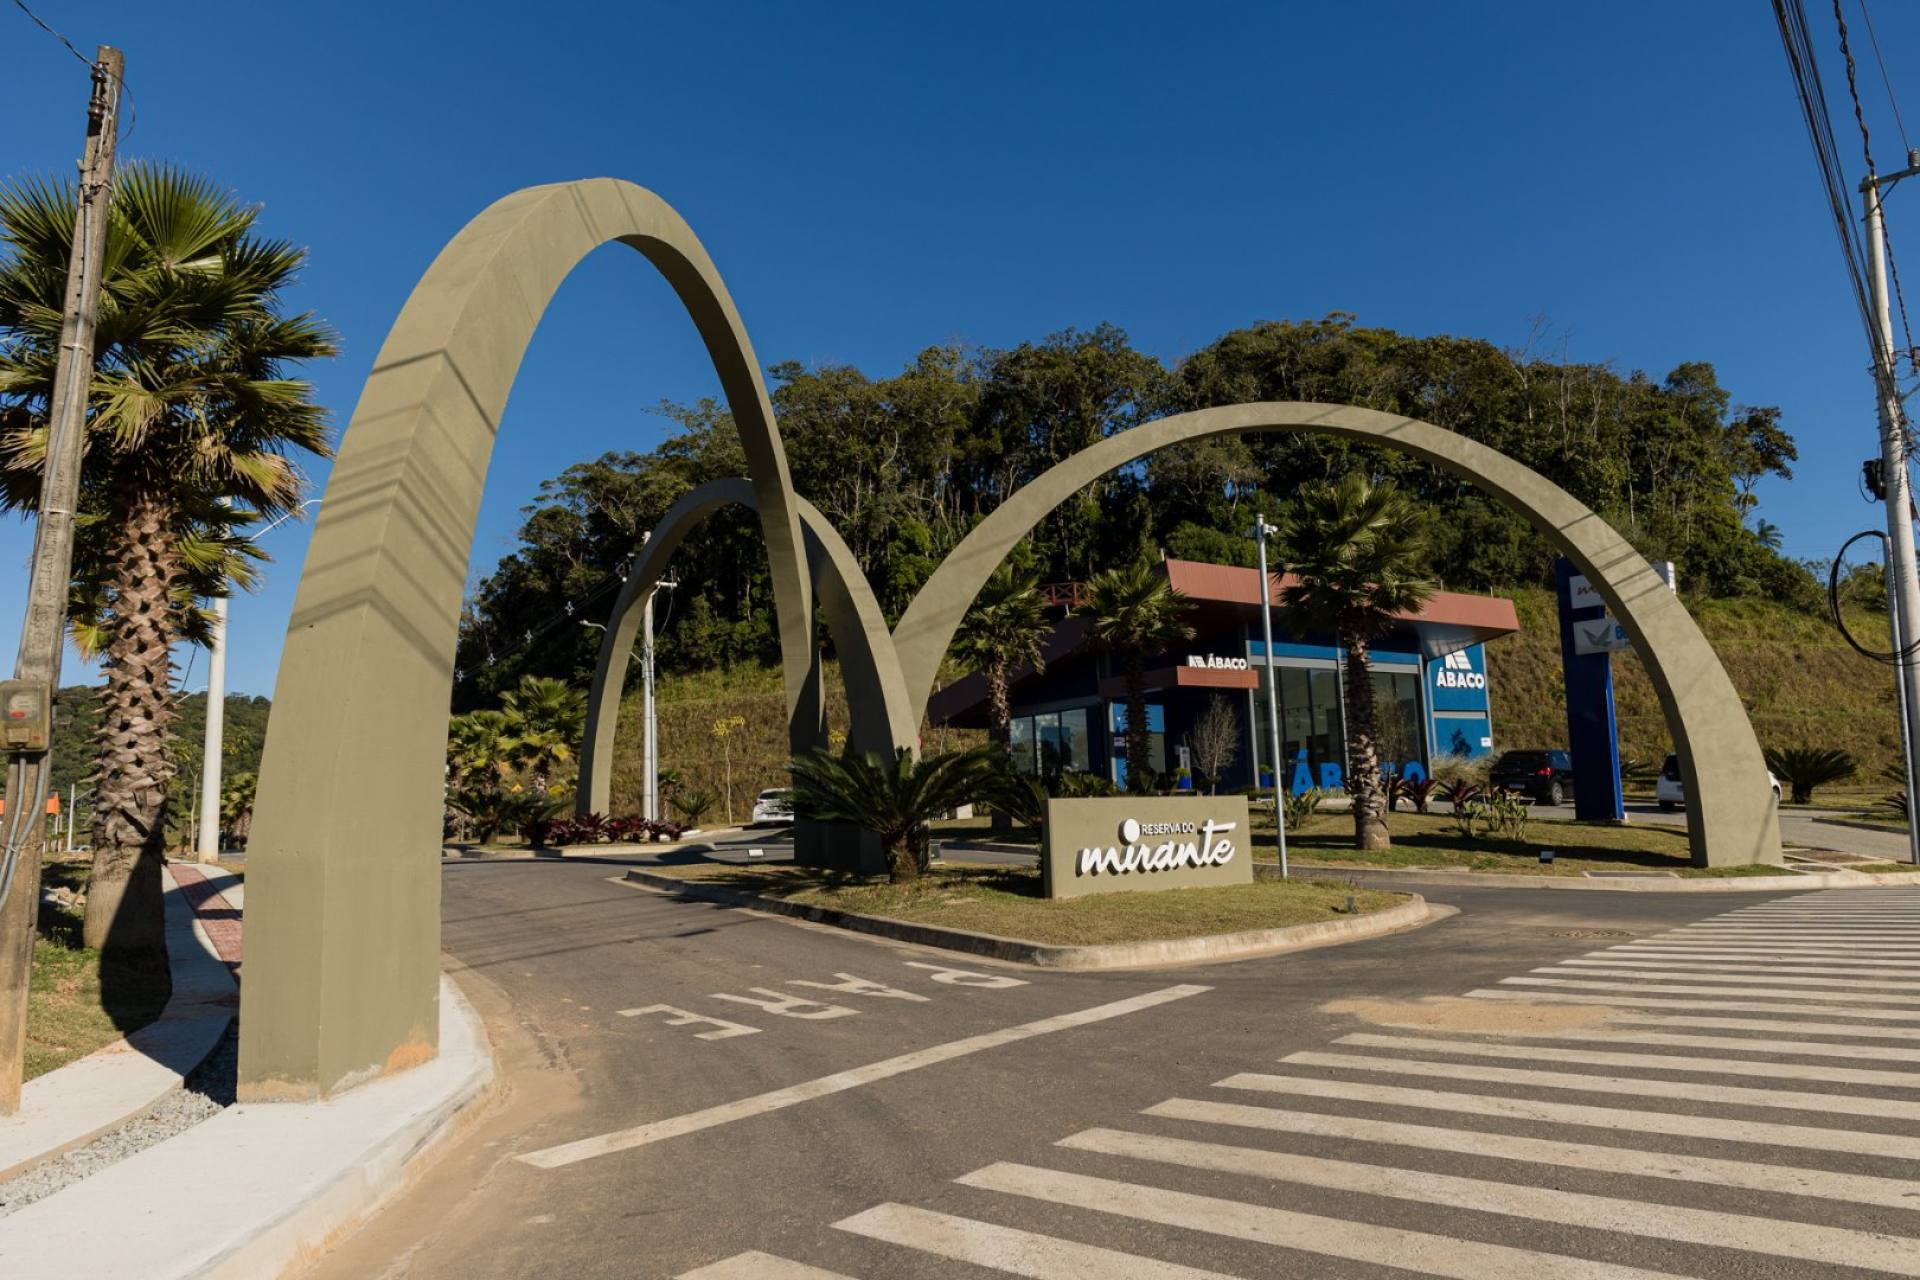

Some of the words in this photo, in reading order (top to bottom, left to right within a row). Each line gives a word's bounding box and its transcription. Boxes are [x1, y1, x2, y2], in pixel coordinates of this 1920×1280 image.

[1207, 653, 1247, 671] ÁBACO
[1437, 667, 1485, 689] ÁBACO
[1141, 823, 1181, 835] RESERVA
[1183, 822, 1195, 833] DO
[1081, 818, 1237, 874] mirante
[616, 961, 1032, 1041] PARE
